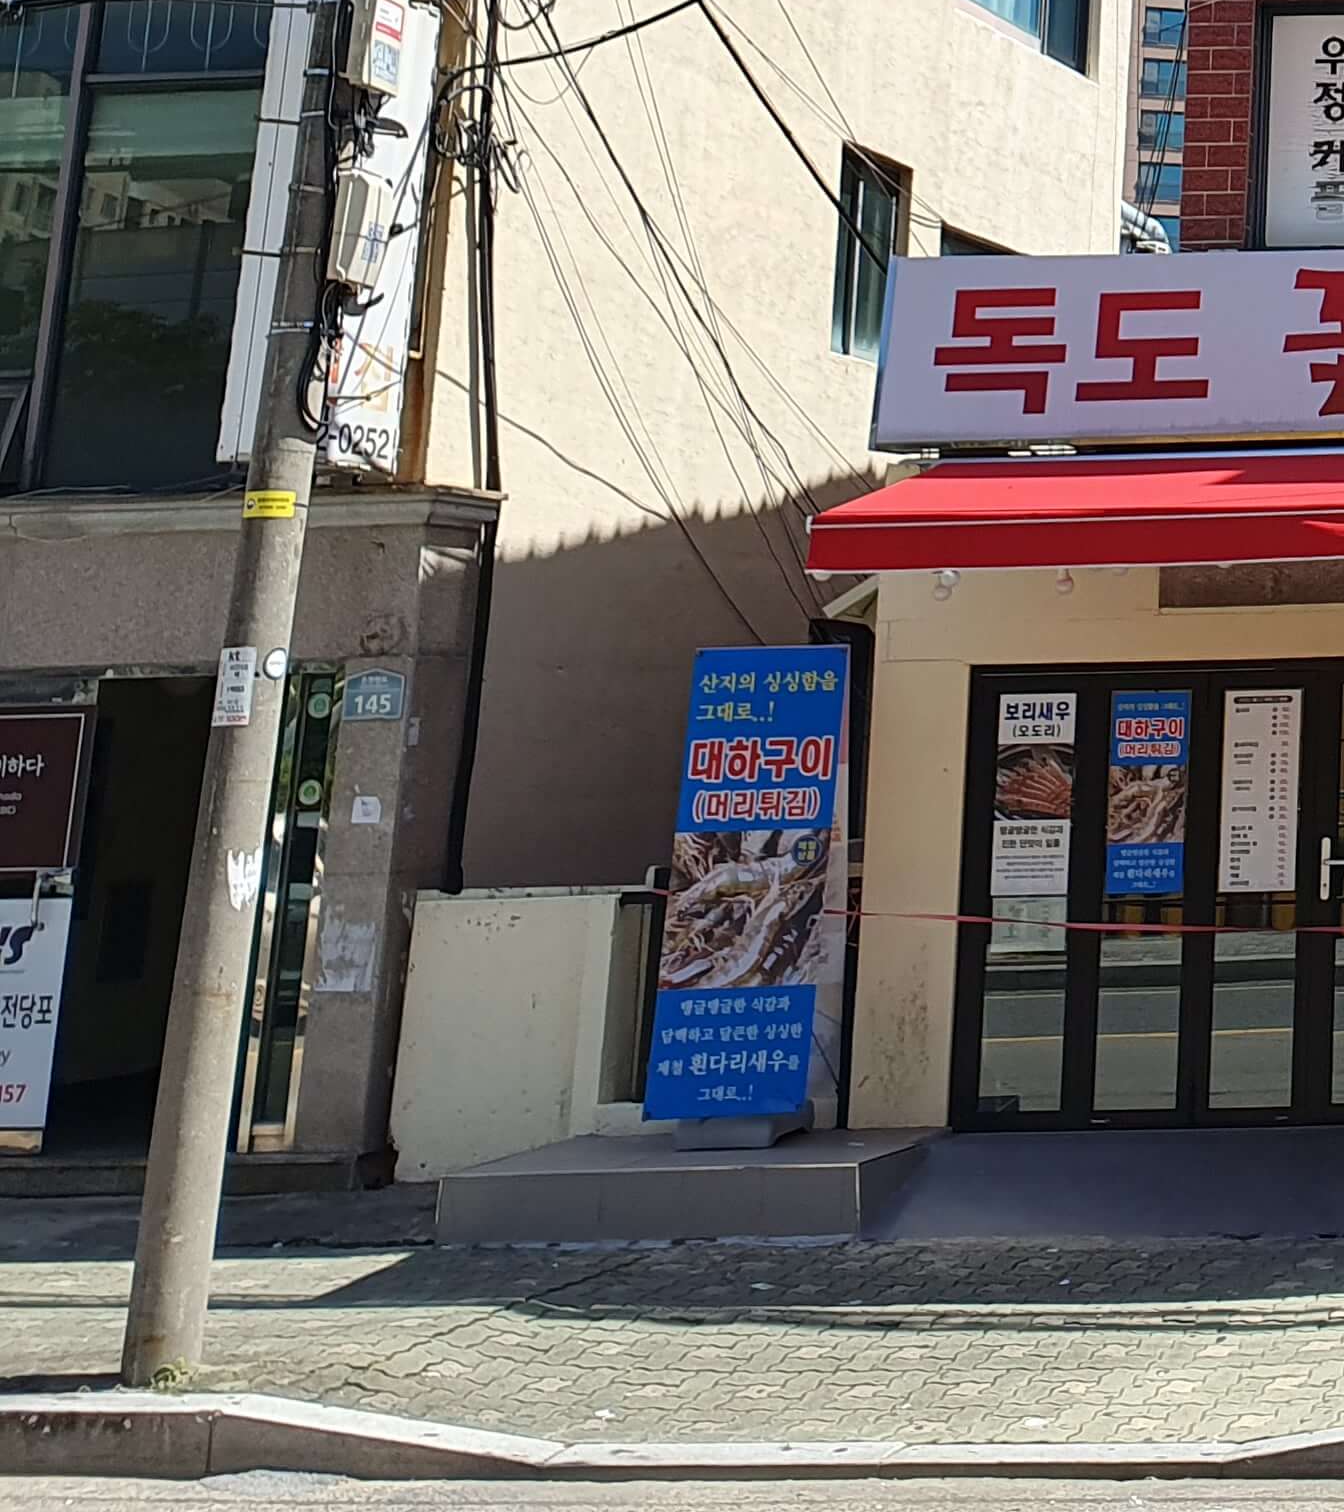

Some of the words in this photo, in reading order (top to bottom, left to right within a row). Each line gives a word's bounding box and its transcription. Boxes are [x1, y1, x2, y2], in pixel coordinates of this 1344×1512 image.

[932, 286, 1209, 414] 독도
[699, 672, 756, 694] 산지의
[763, 670, 839, 693] 싱싱함을
[354, 694, 392, 714] 145
[1004, 701, 1071, 722] 보리새우
[1116, 717, 1185, 739] 대하구이
[688, 736, 835, 783] 대하구이
[693, 787, 821, 822] (머리튀김)
[0, 994, 54, 1029] 전당포
